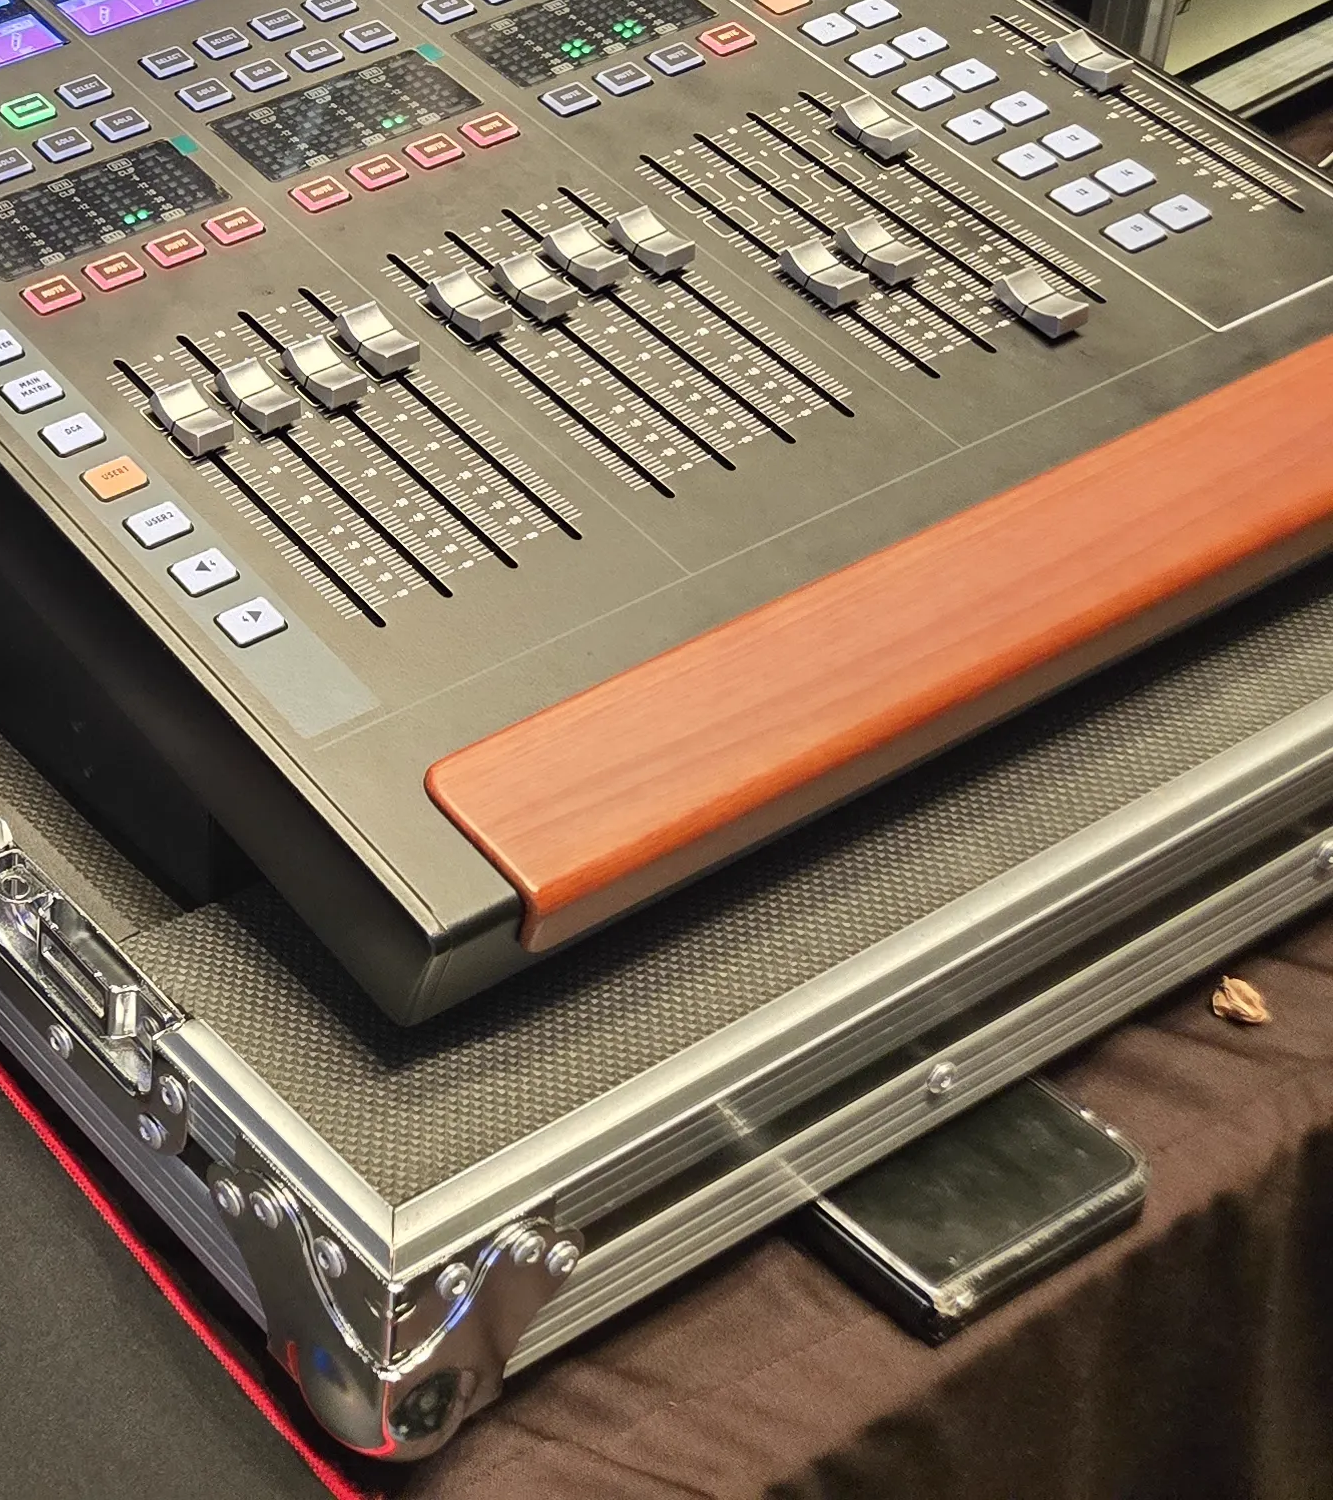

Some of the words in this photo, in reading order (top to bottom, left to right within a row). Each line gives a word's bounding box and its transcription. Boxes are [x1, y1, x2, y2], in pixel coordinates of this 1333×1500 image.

[439, 0, 459, 9] SOLO
[265, 14, 291, 26] SELECT
[361, 27, 381, 38] SOLO
[718, 29, 740, 41] MUTE
[211, 34, 236, 46] SELECT
[307, 46, 327, 57] SOLO
[666, 49, 689, 61] MUTE
[155, 52, 181, 65] SELECT
[252, 66, 272, 77] SOLO
[613, 69, 636, 81] MUTE
[72, 81, 100, 95] SELECT
[196, 85, 217, 97] SOLO
[560, 89, 582, 101] MUTE
[113, 114, 133, 126] SOLO
[479, 120, 503, 133] MUTE
[55, 135, 76, 146] SOLO
[424, 141, 447, 153] MUTE
[118, 166, 135, 177] CLIP
[368, 163, 391, 175] MUTE
[59, 187, 76, 198] CLIP
[310, 183, 334, 197] MUTE
[225, 216, 248, 229] MUTE
[164, 239, 188, 253] MUTE
[103, 260, 128, 275] MUTE
[41, 284, 65, 299] MUTE
[19, 377, 41, 389] MAIN
[21, 382, 52, 398] MATRIX
[64, 424, 83, 435] DCA
[101, 466, 124, 480] USER
[145, 513, 169, 527] USER
